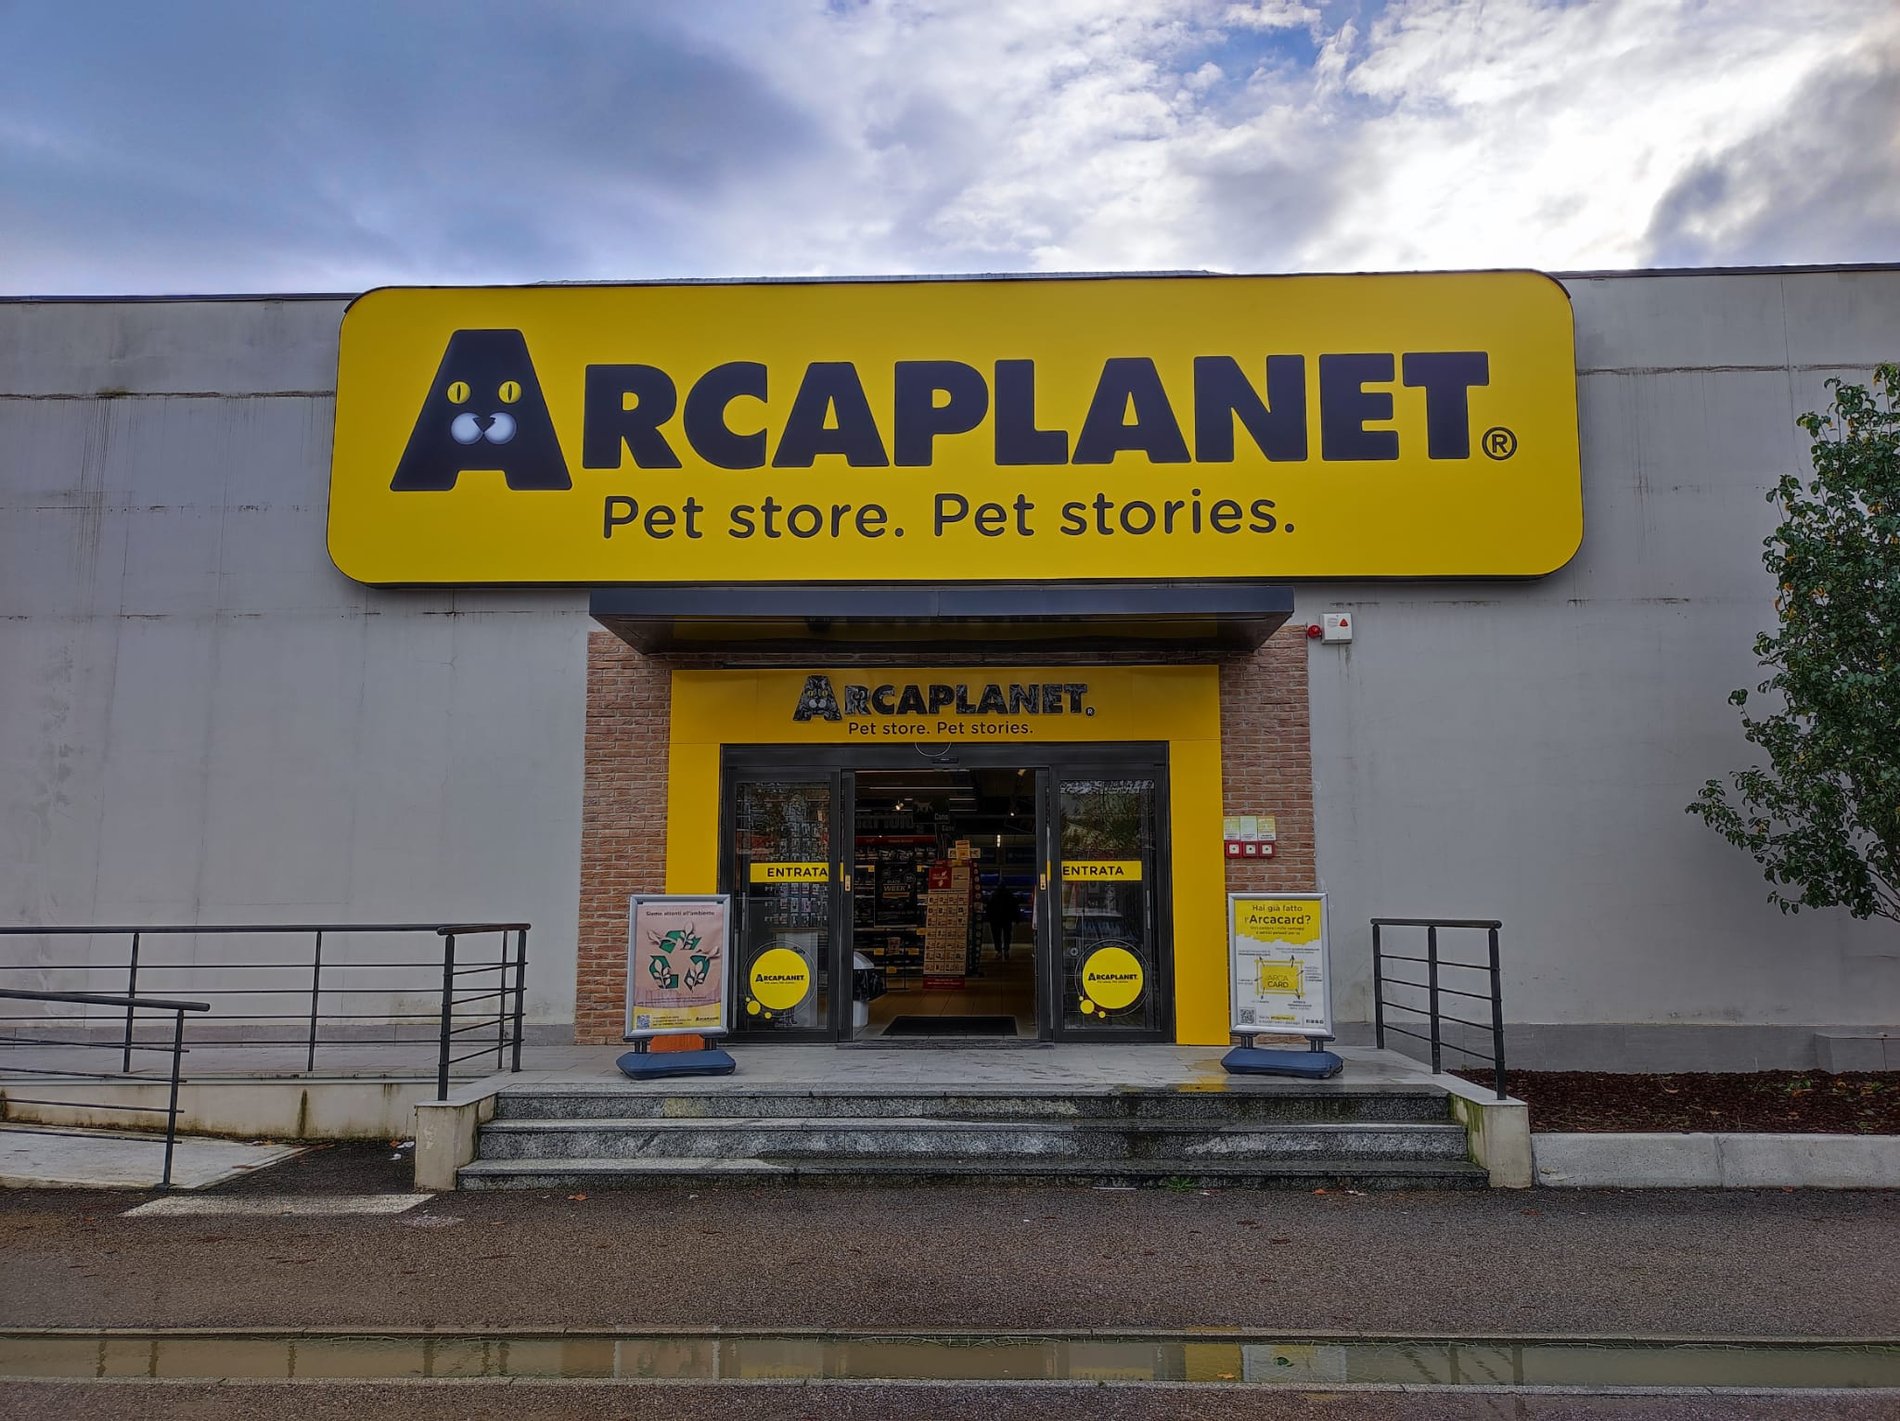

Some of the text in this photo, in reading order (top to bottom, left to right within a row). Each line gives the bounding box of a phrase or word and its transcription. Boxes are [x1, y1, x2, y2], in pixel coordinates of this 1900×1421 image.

[603, 488, 1295, 539] Pet store. Pet stories.
[848, 720, 1033, 735] Pet store. Pet stories.
[767, 867, 828, 877] ENTRATA
[1062, 866, 1124, 876] ENTRATA
[1283, 904, 1303, 912] fatto
